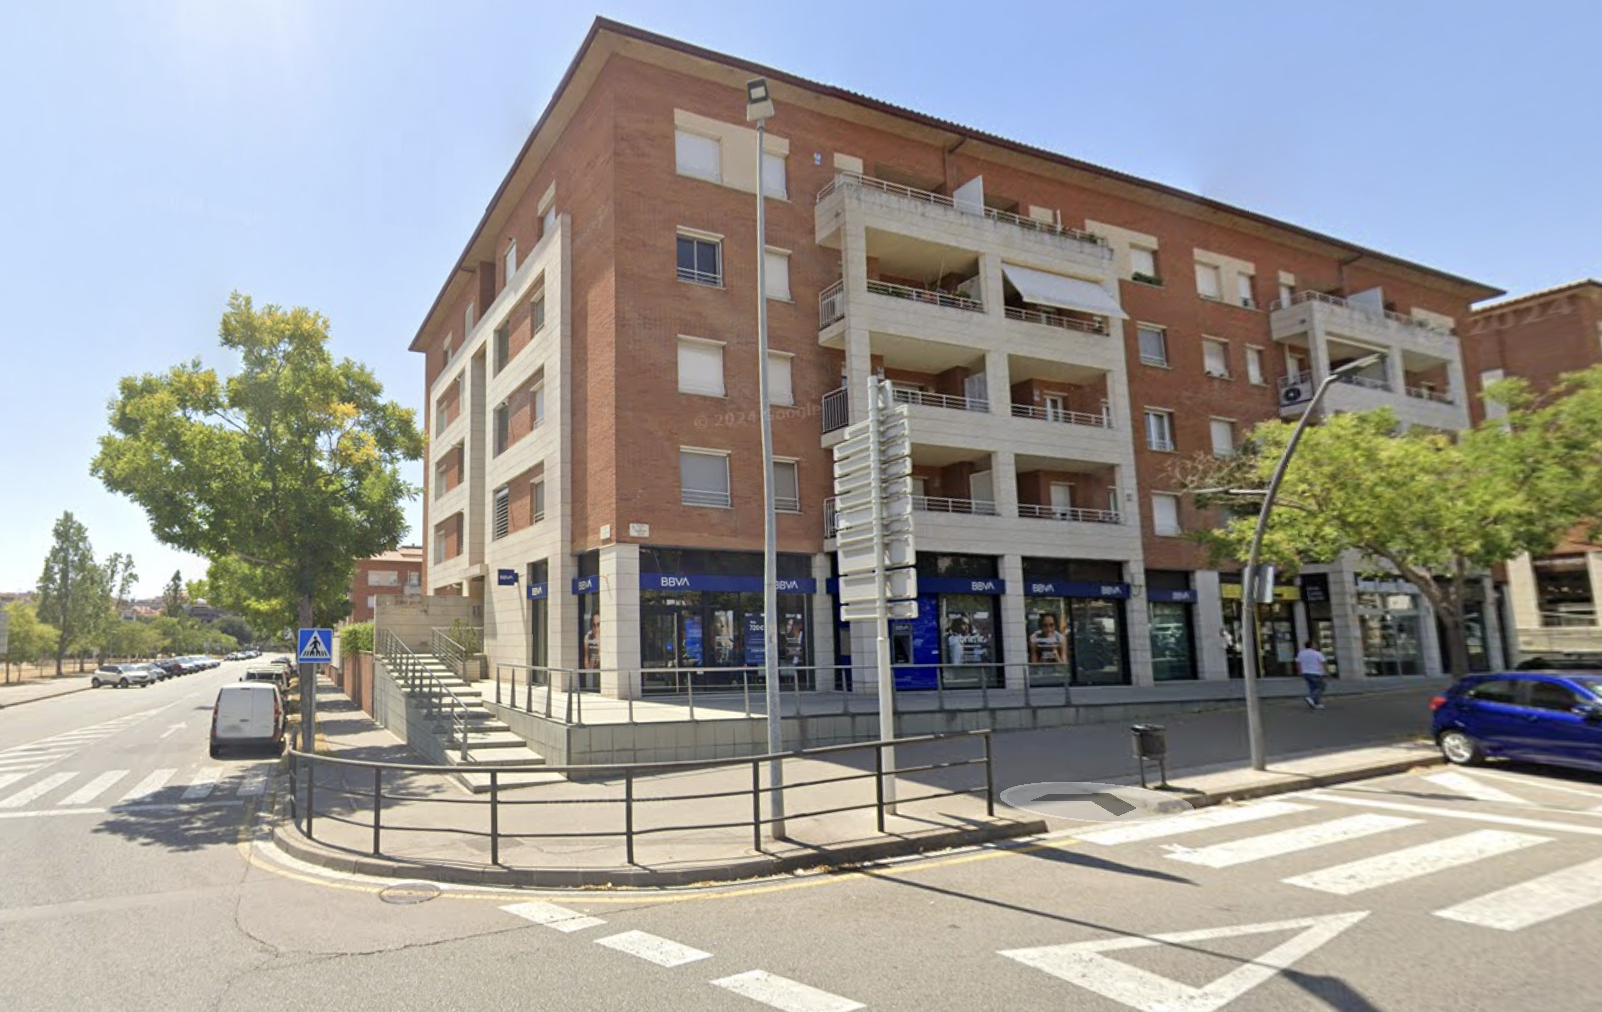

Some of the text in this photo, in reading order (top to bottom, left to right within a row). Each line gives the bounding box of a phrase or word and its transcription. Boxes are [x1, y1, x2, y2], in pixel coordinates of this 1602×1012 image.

[578, 579, 592, 590] BBVA
[661, 576, 690, 587] BBVA
[971, 581, 995, 591] BBVA
[1032, 583, 1055, 593] BBVA
[1100, 585, 1122, 595] BBVA
